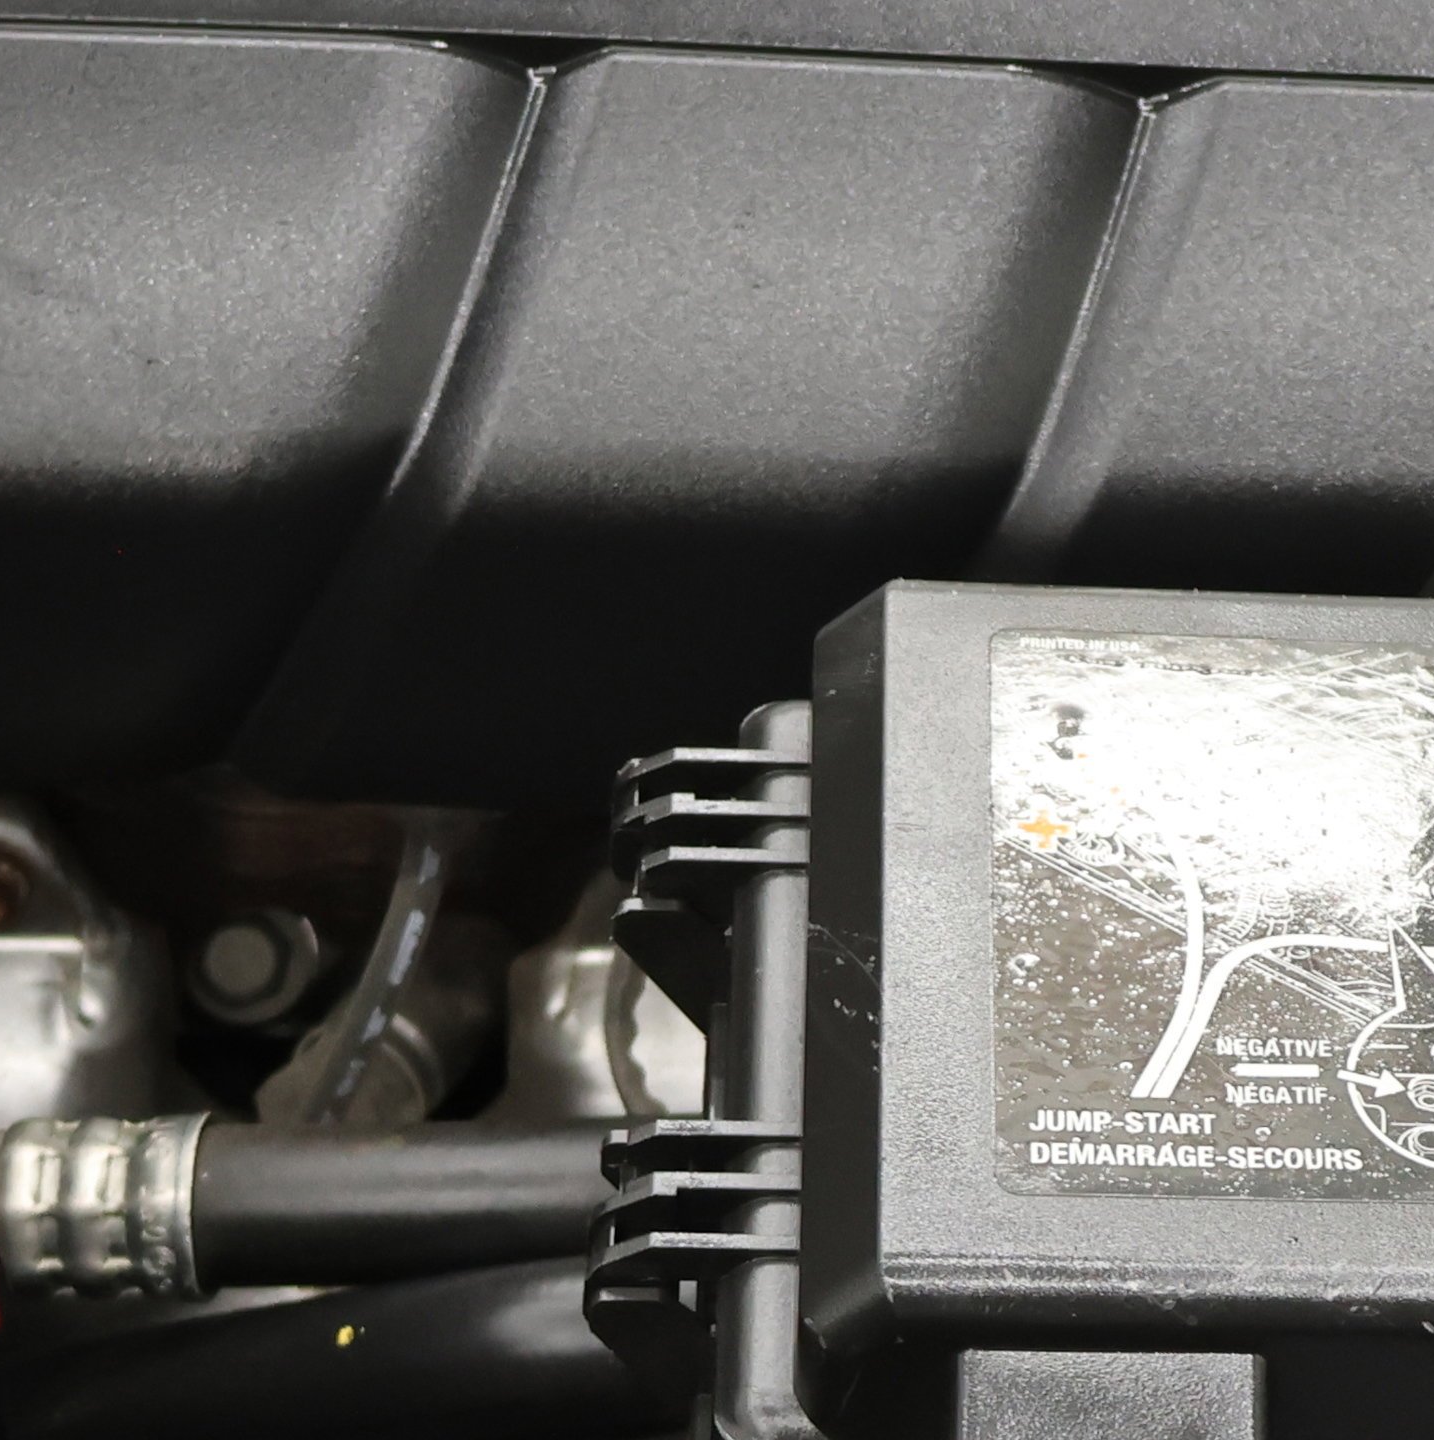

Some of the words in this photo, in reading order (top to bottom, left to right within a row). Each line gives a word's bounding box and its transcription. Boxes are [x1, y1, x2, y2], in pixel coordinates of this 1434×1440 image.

[1020, 637, 1084, 650] PRINTED
[1111, 640, 1141, 651] USA
[1217, 1037, 1333, 1058] NEGATIVE
[1029, 1110, 1216, 1135] JUMP-START
